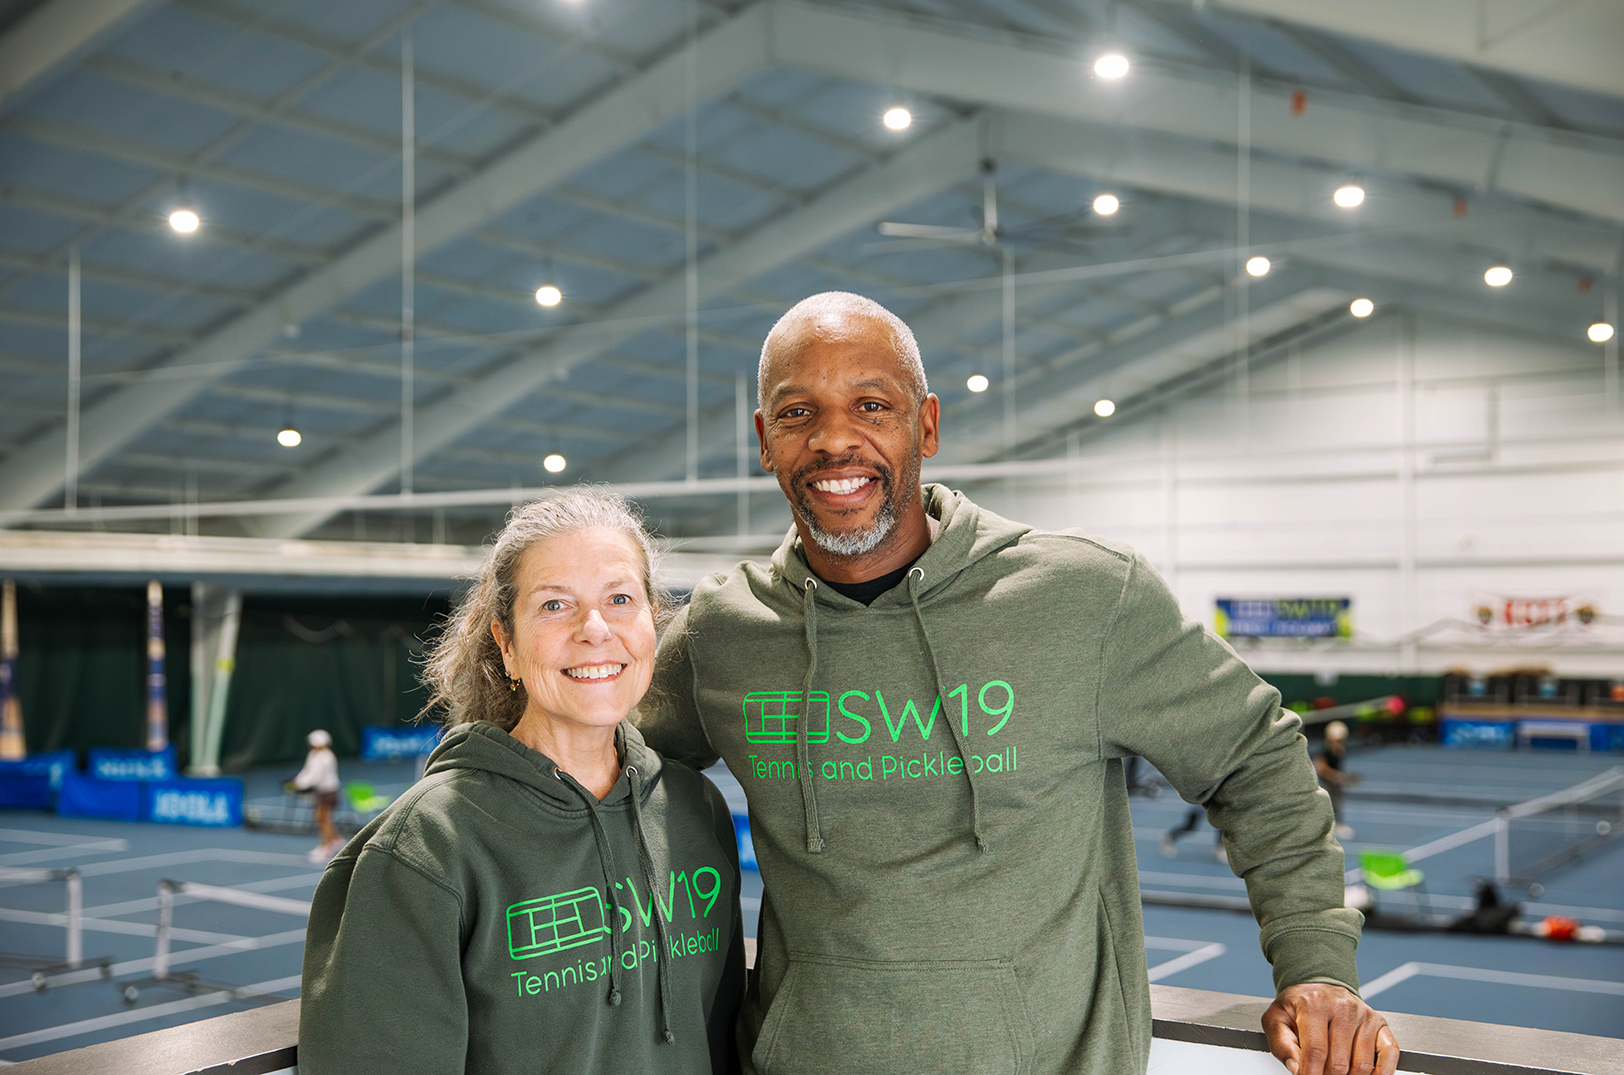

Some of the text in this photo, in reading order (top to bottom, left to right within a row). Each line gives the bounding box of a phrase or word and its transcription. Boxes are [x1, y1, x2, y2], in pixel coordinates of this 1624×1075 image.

[836, 679, 1015, 745] SW19
[821, 755, 874, 781] and
[603, 865, 722, 935] SW19
[510, 958, 598, 998] Tennis
[639, 927, 720, 966] Pikleball
